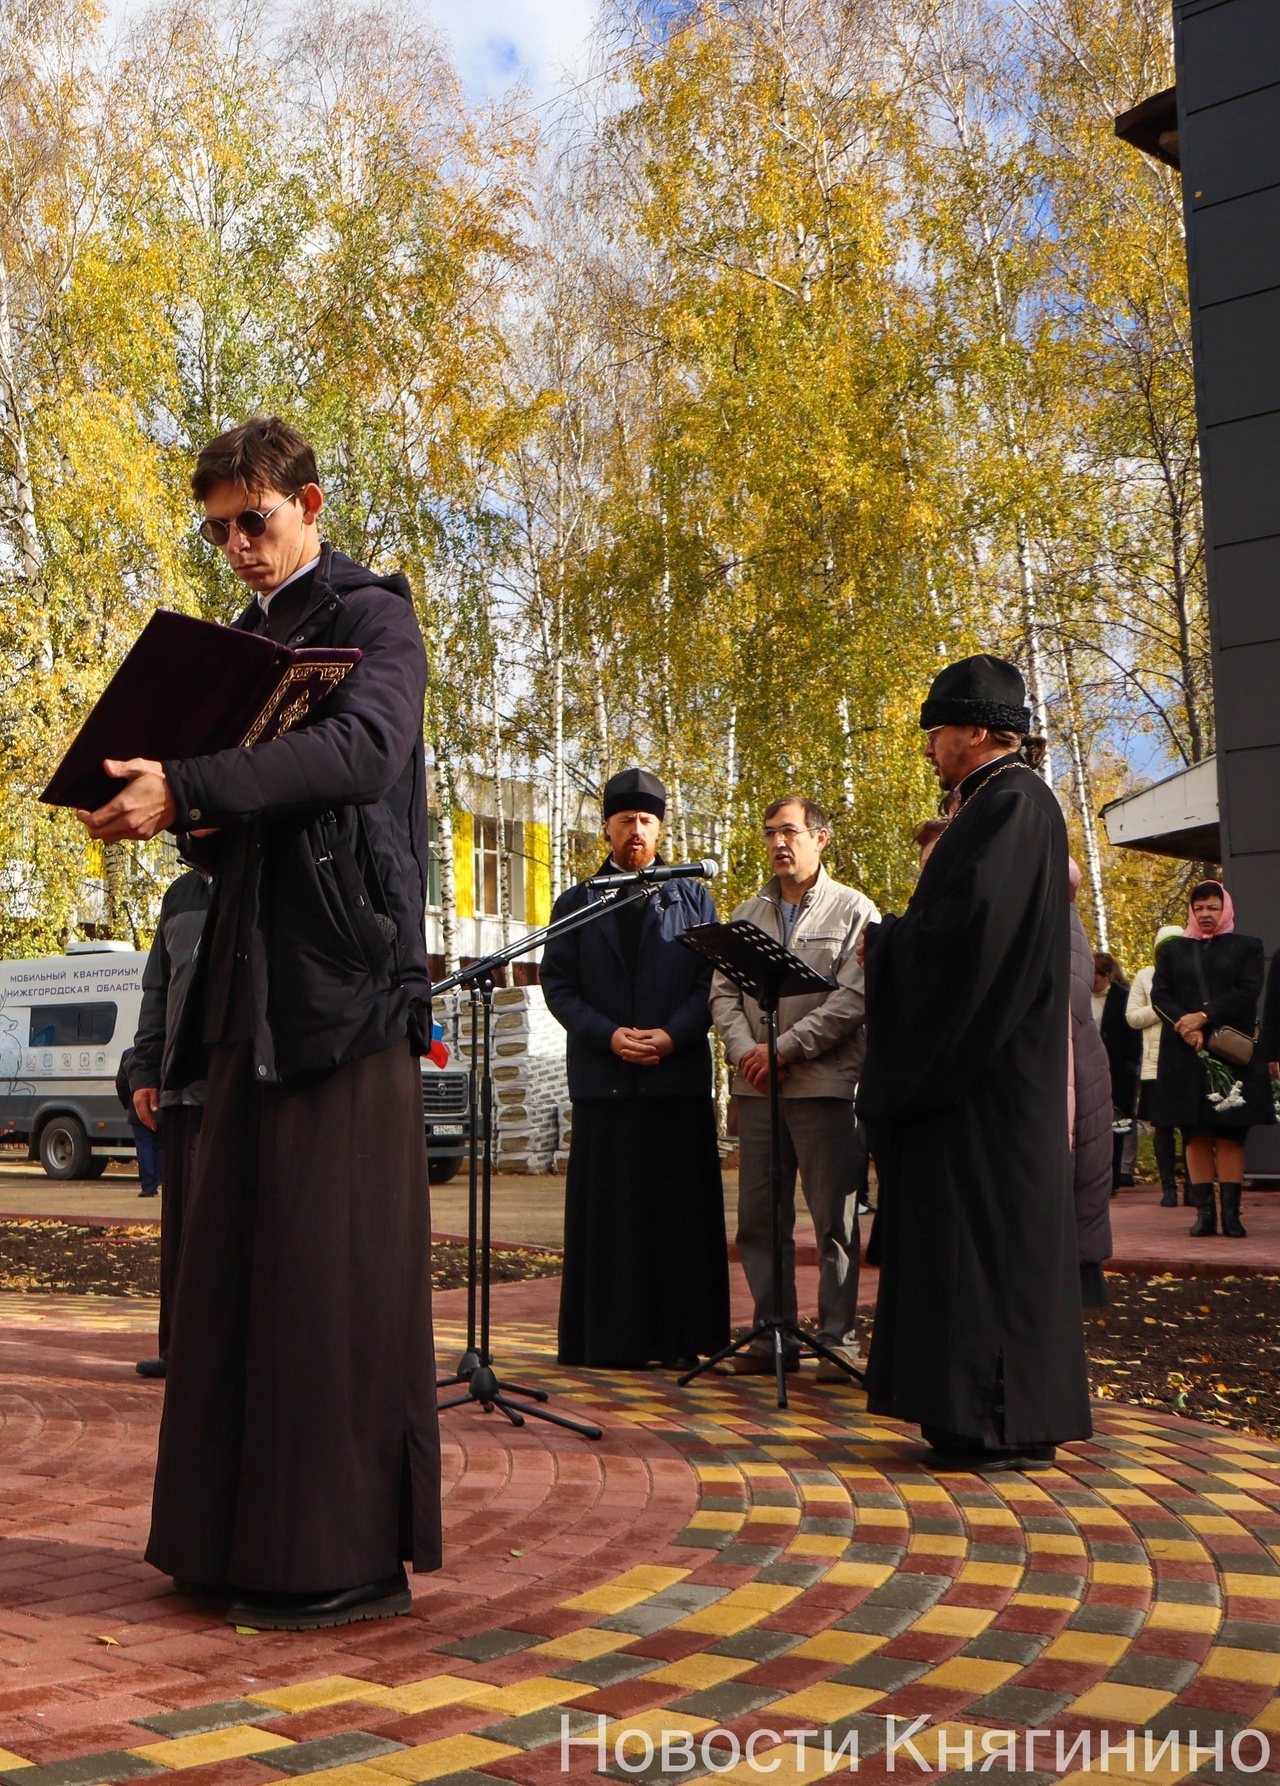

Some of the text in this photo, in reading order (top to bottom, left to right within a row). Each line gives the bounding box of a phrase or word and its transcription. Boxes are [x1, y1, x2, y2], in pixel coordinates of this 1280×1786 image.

[10, 968, 139, 983] МОБИЛЬНЫЙ КВАНТОРИУМ
[7, 982, 141, 997] НИЖЕГОРОДСКАЯ ОБЛАСТЬ
